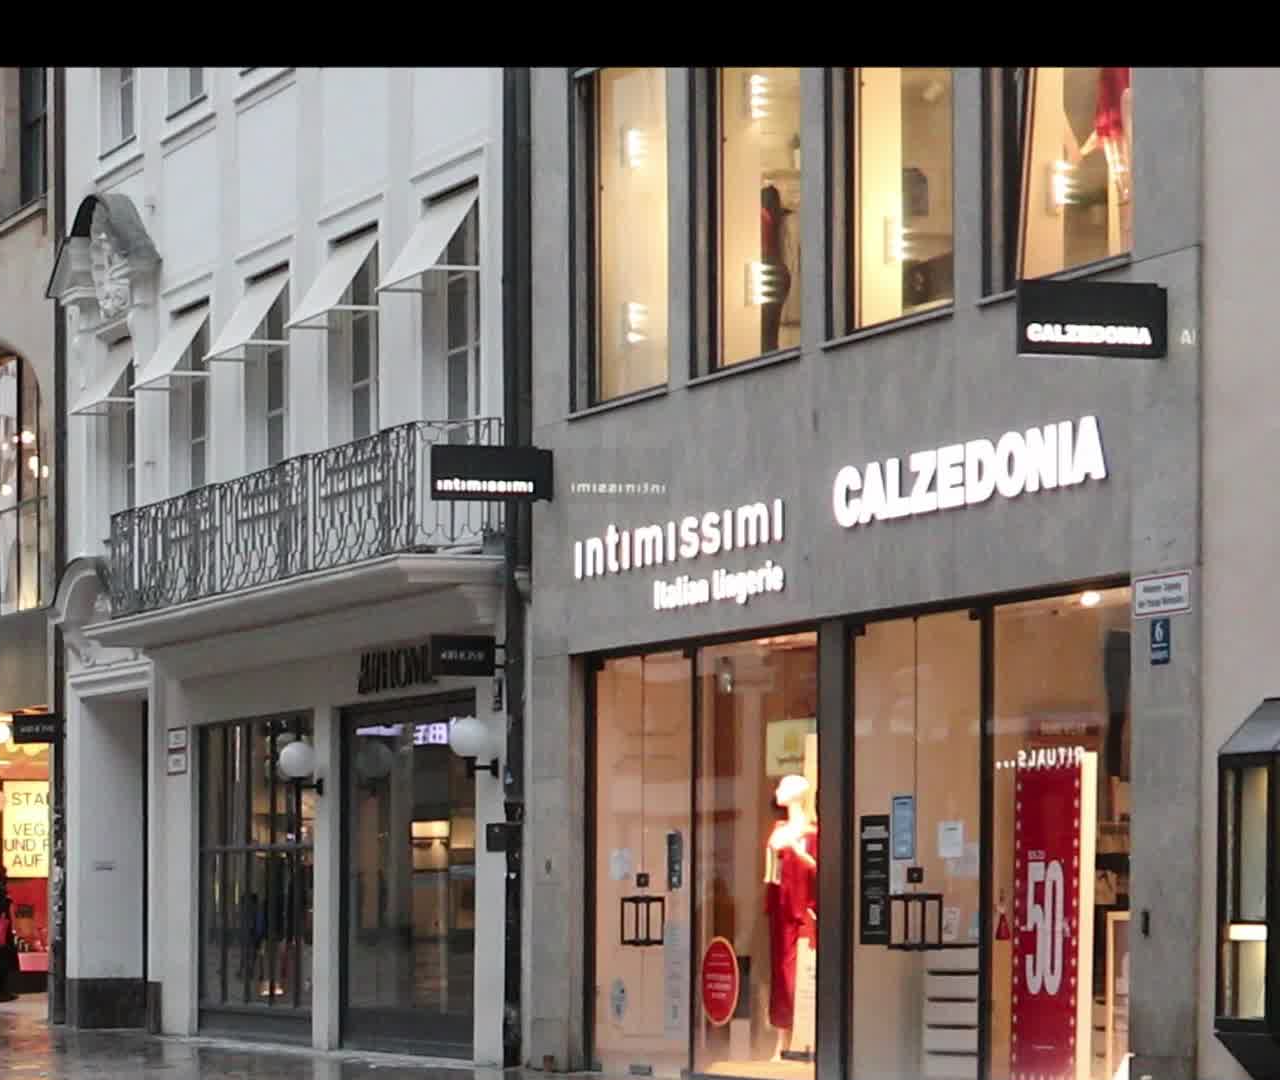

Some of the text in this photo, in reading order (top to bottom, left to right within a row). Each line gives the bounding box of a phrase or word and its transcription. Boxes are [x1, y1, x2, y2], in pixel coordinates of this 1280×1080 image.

[1026, 323, 1153, 345] CALZEDONIA
[833, 415, 1106, 528] CALZEDONIA
[574, 498, 783, 580] intimissimi
[654, 575, 709, 610] Italian
[1154, 621, 1164, 641] 6
[4, 839, 36, 852] UND
[12, 854, 43, 867] AUF
